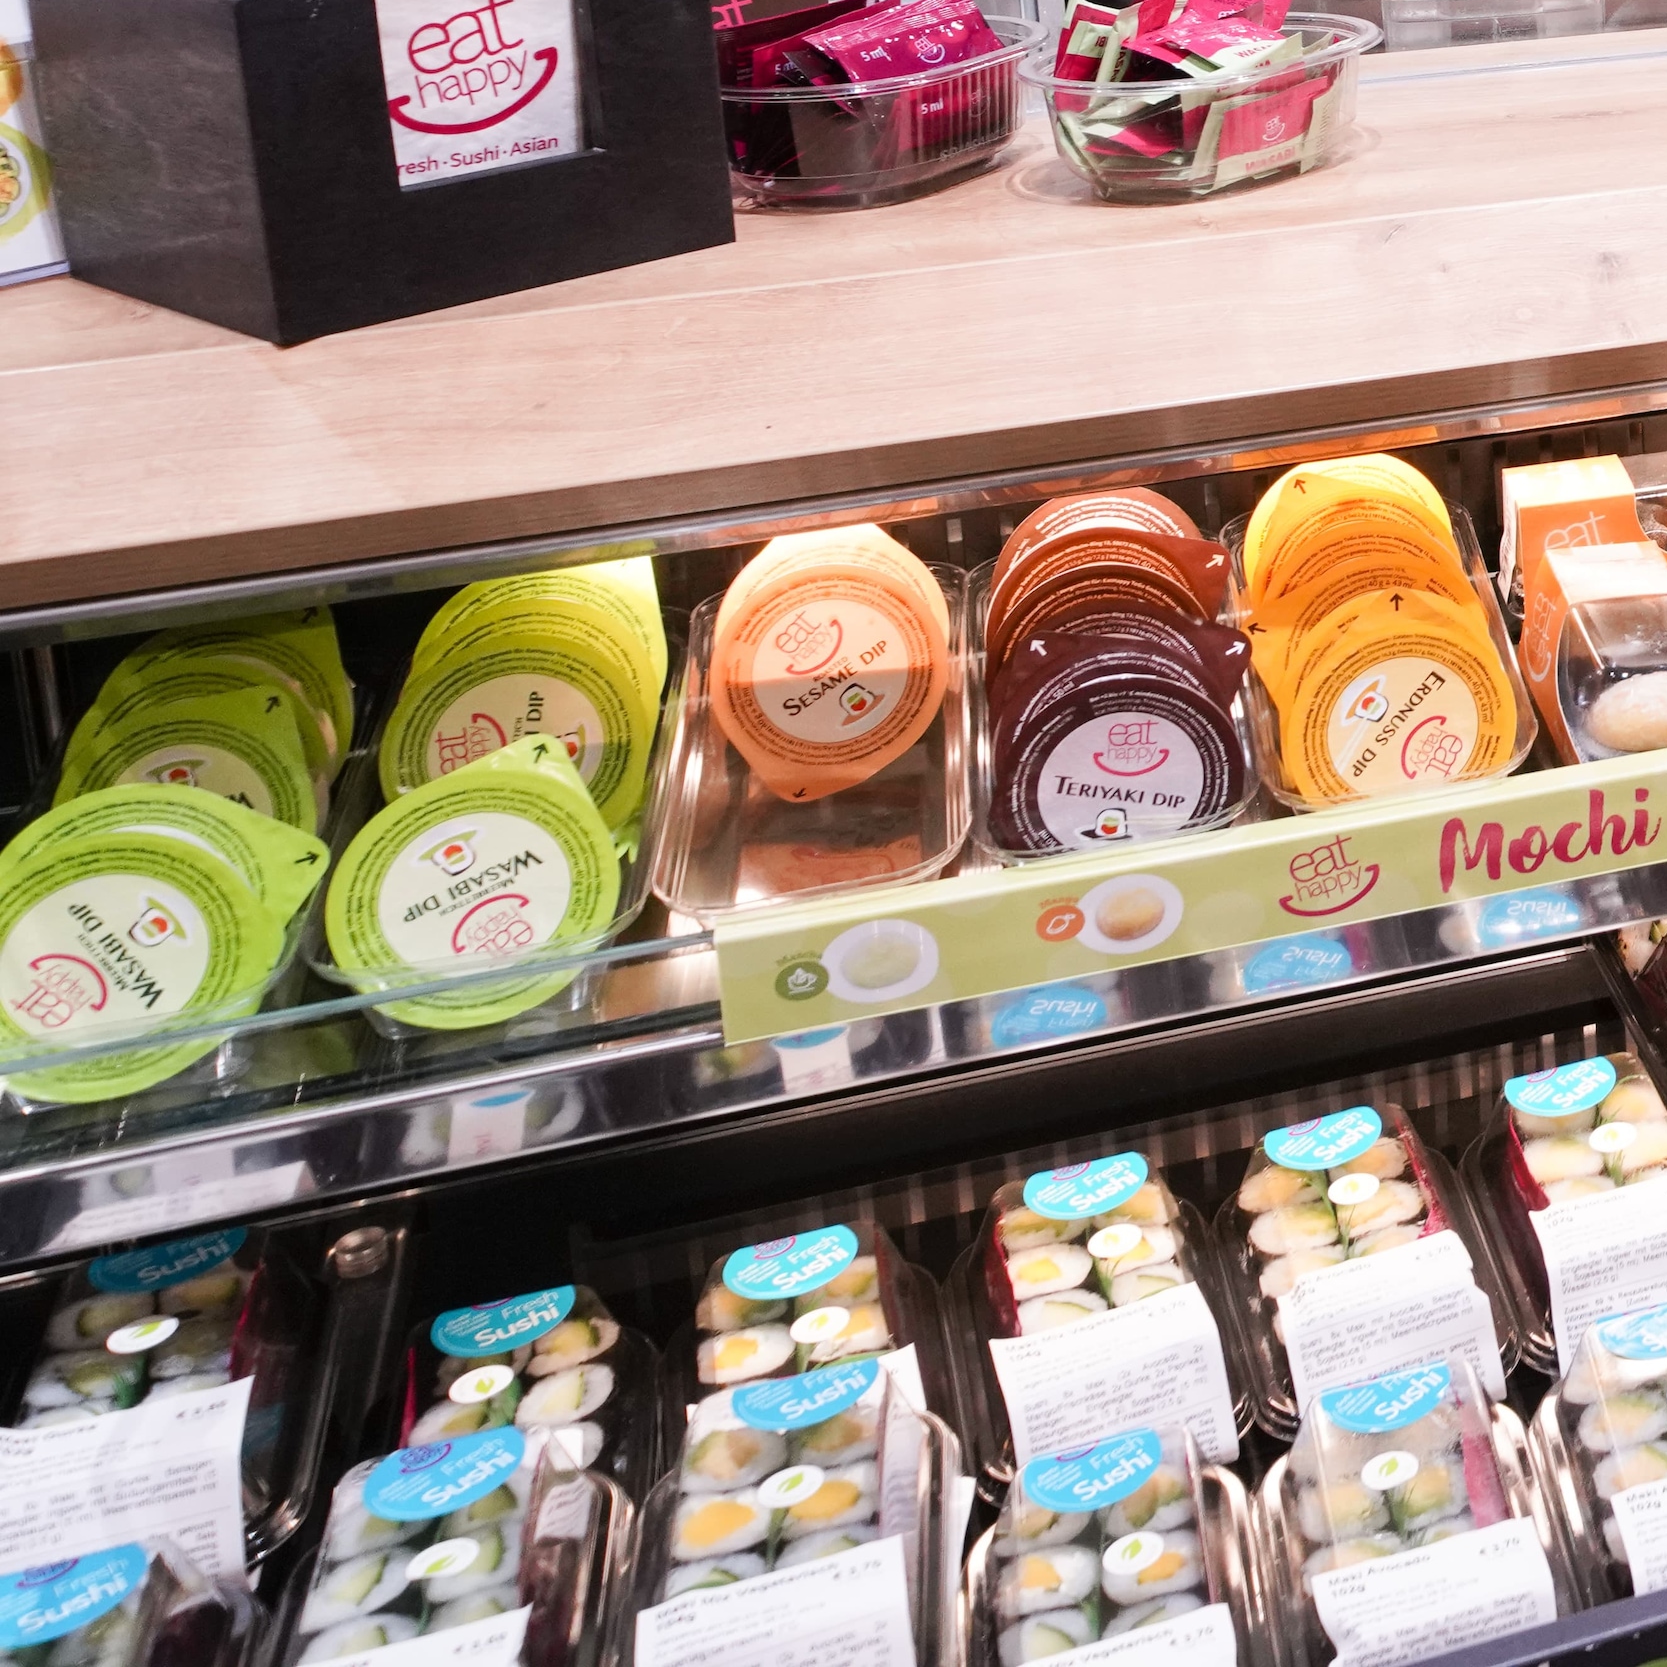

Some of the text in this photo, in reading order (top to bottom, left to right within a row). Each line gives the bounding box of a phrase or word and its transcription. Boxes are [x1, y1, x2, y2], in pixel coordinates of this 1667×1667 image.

[861, 51, 870, 62] 5
[414, 53, 531, 109] happy
[921, 100, 945, 115] 5 ml
[450, 135, 559, 167] Sushi Asian
[775, 610, 821, 654] eat
[783, 639, 888, 716] SESAME DIP
[525, 690, 546, 723] DIP
[1353, 669, 1447, 778] ERDNUSS DIP
[1106, 743, 1158, 764] happy
[1108, 720, 1160, 746] eat
[1410, 726, 1448, 769] happy
[1425, 733, 1464, 778] eat
[1054, 774, 1186, 809] TERIYAKI DIP
[1289, 834, 1360, 884] eat
[1438, 787, 1663, 895] Mochi
[402, 849, 544, 924] WASABI DIP
[1294, 866, 1364, 903] happy
[464, 905, 523, 945] happy
[67, 903, 166, 1010] WASABI DIP
[10, 977, 80, 1029] eat
[39, 962, 96, 1011] happy
[1552, 1070, 1611, 1109] Sushi
[1313, 1120, 1375, 1162] Sushi
[1068, 1168, 1140, 1213] Sushi
[771, 1245, 849, 1291] Sushi
[473, 1303, 560, 1349] Sushi
[780, 1372, 869, 1422] Sushi
[1374, 1367, 1443, 1421] Sushi
[420, 1447, 517, 1509] Sushi
[1073, 1449, 1154, 1502] Sushi
[16, 1573, 130, 1635] Sushi
